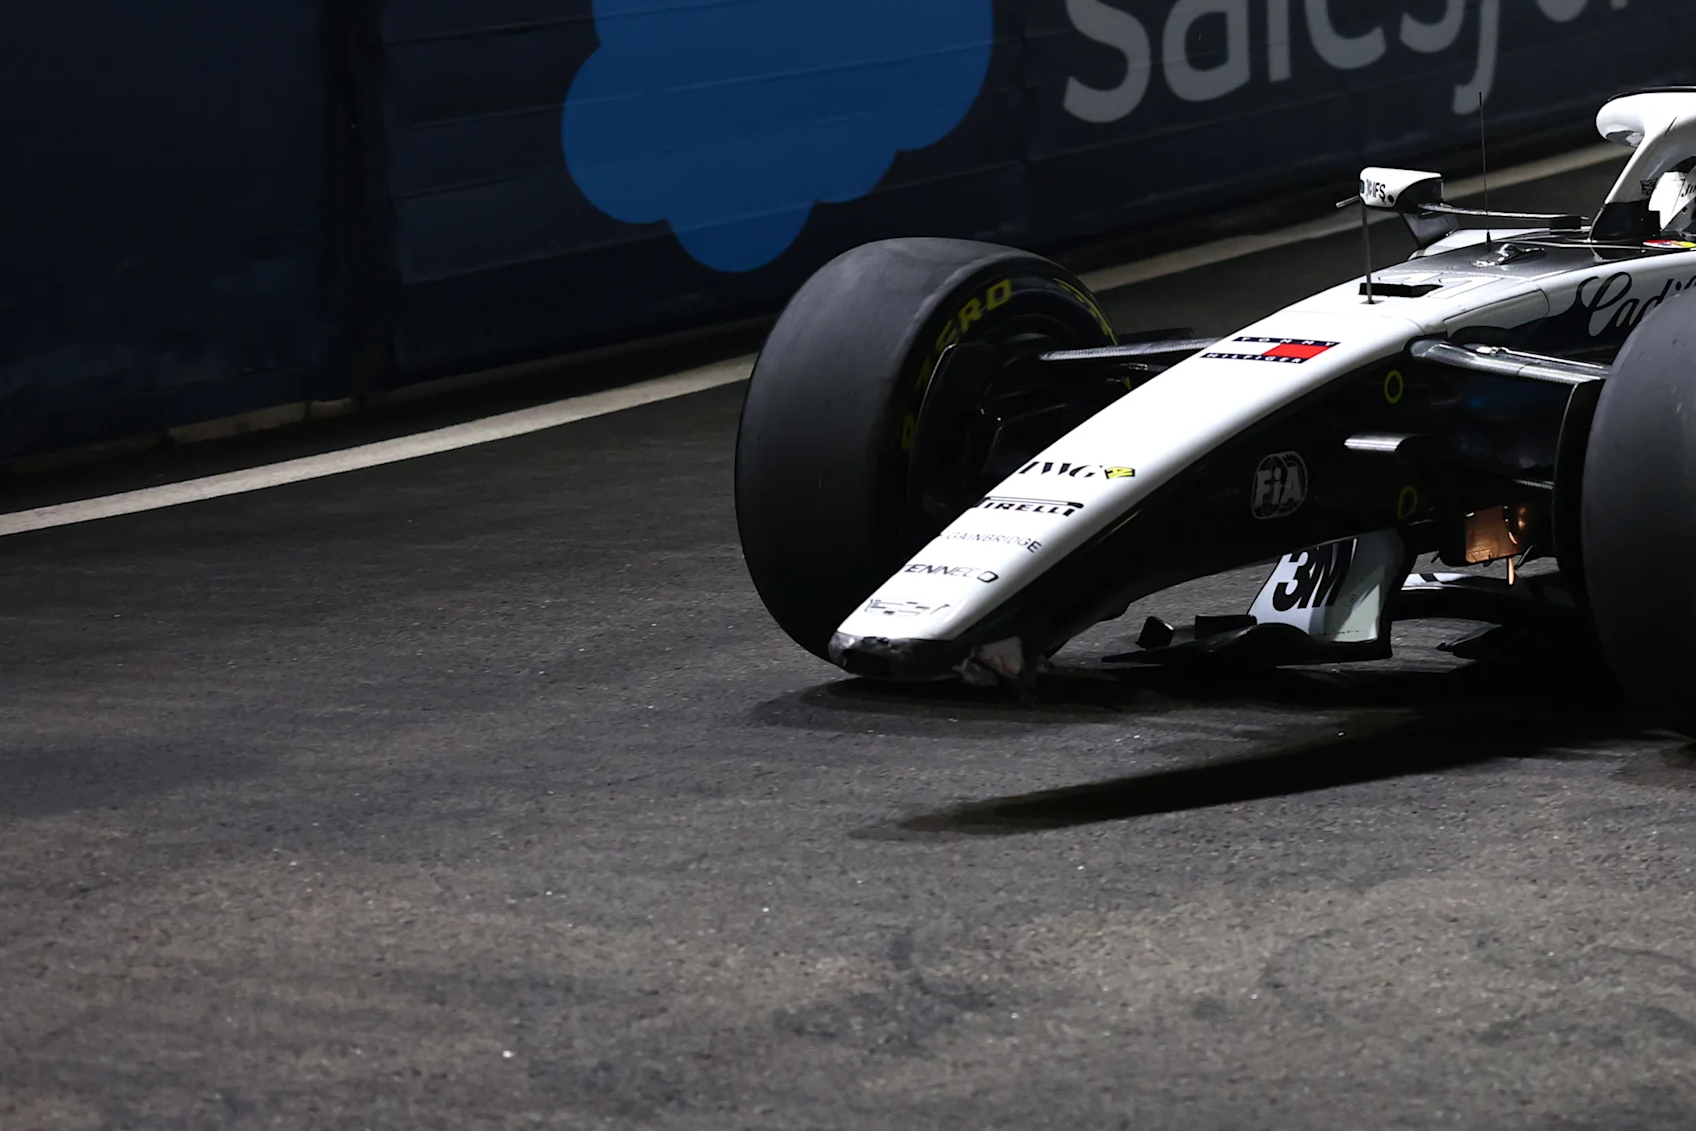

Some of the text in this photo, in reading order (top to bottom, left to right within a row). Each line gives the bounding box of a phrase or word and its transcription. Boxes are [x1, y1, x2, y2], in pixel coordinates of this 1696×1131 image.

[1242, 337, 1336, 347] TOMMY
[1206, 353, 1302, 364] HILFIGER
[946, 531, 1042, 554] GAINBRIDGE
